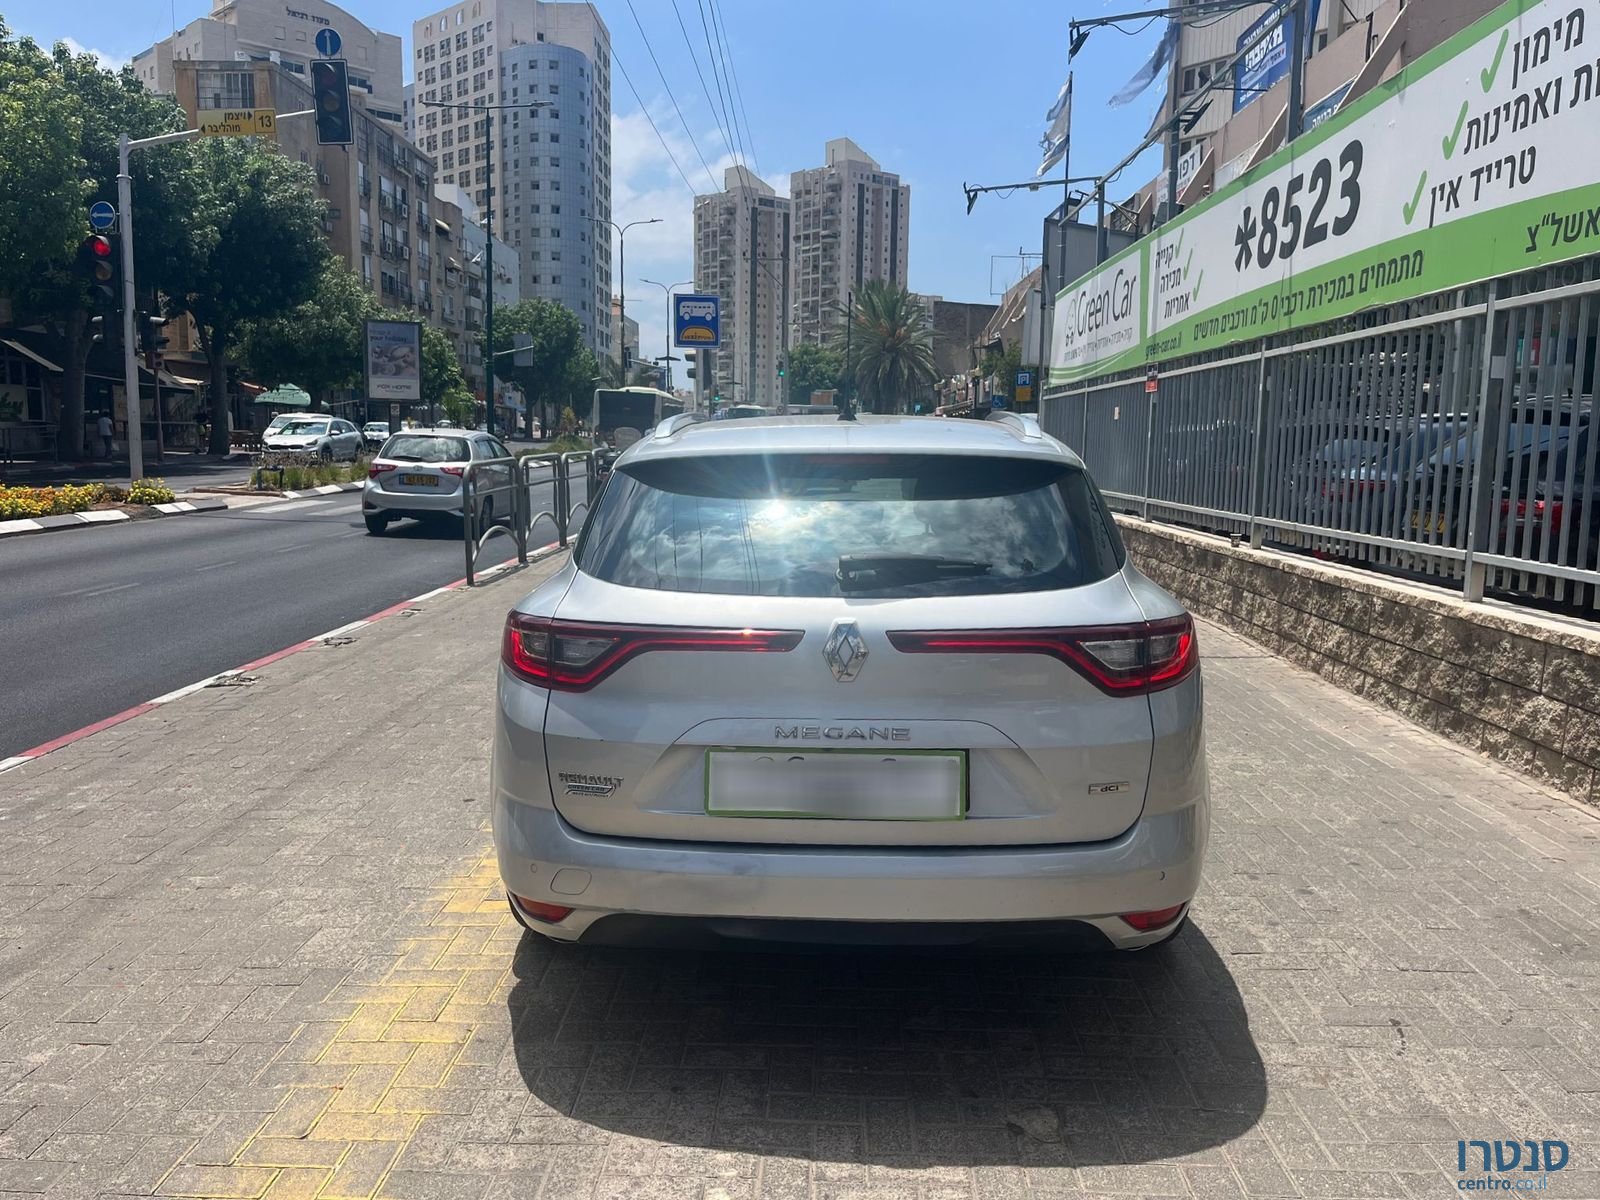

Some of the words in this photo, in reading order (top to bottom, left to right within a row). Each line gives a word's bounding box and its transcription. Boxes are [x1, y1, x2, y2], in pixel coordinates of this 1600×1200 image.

[1511, 7, 1585, 90] מימון
[208, 122, 240, 132] מוהליבר
[224, 111, 246, 123] ויצמן
[258, 115, 272, 128] 13
[1463, 76, 1563, 155] ואמינות
[1179, 152, 1196, 180] דפו
[1470, 145, 1537, 202] טרייד
[1428, 175, 1463, 229] אין
[1155, 243, 1174, 269] קנייה
[1160, 267, 1182, 294] מכירה
[1358, 249, 1424, 294] מתמחים
[1077, 290, 1110, 338] Green
[1112, 268, 1137, 322] Car
[1281, 290, 1304, 318] רכבי
[1306, 272, 1355, 310] במכירת
[1164, 291, 1191, 320] אחריות
[1271, 294, 1279, 321] 0
[1193, 317, 1220, 342] חדשים
[1220, 307, 1249, 333] ורכבים
[1144, 330, 1182, 361] green-car.co.il
[774, 725, 912, 742] MEGANE
[559, 772, 625, 788] RENAULT
